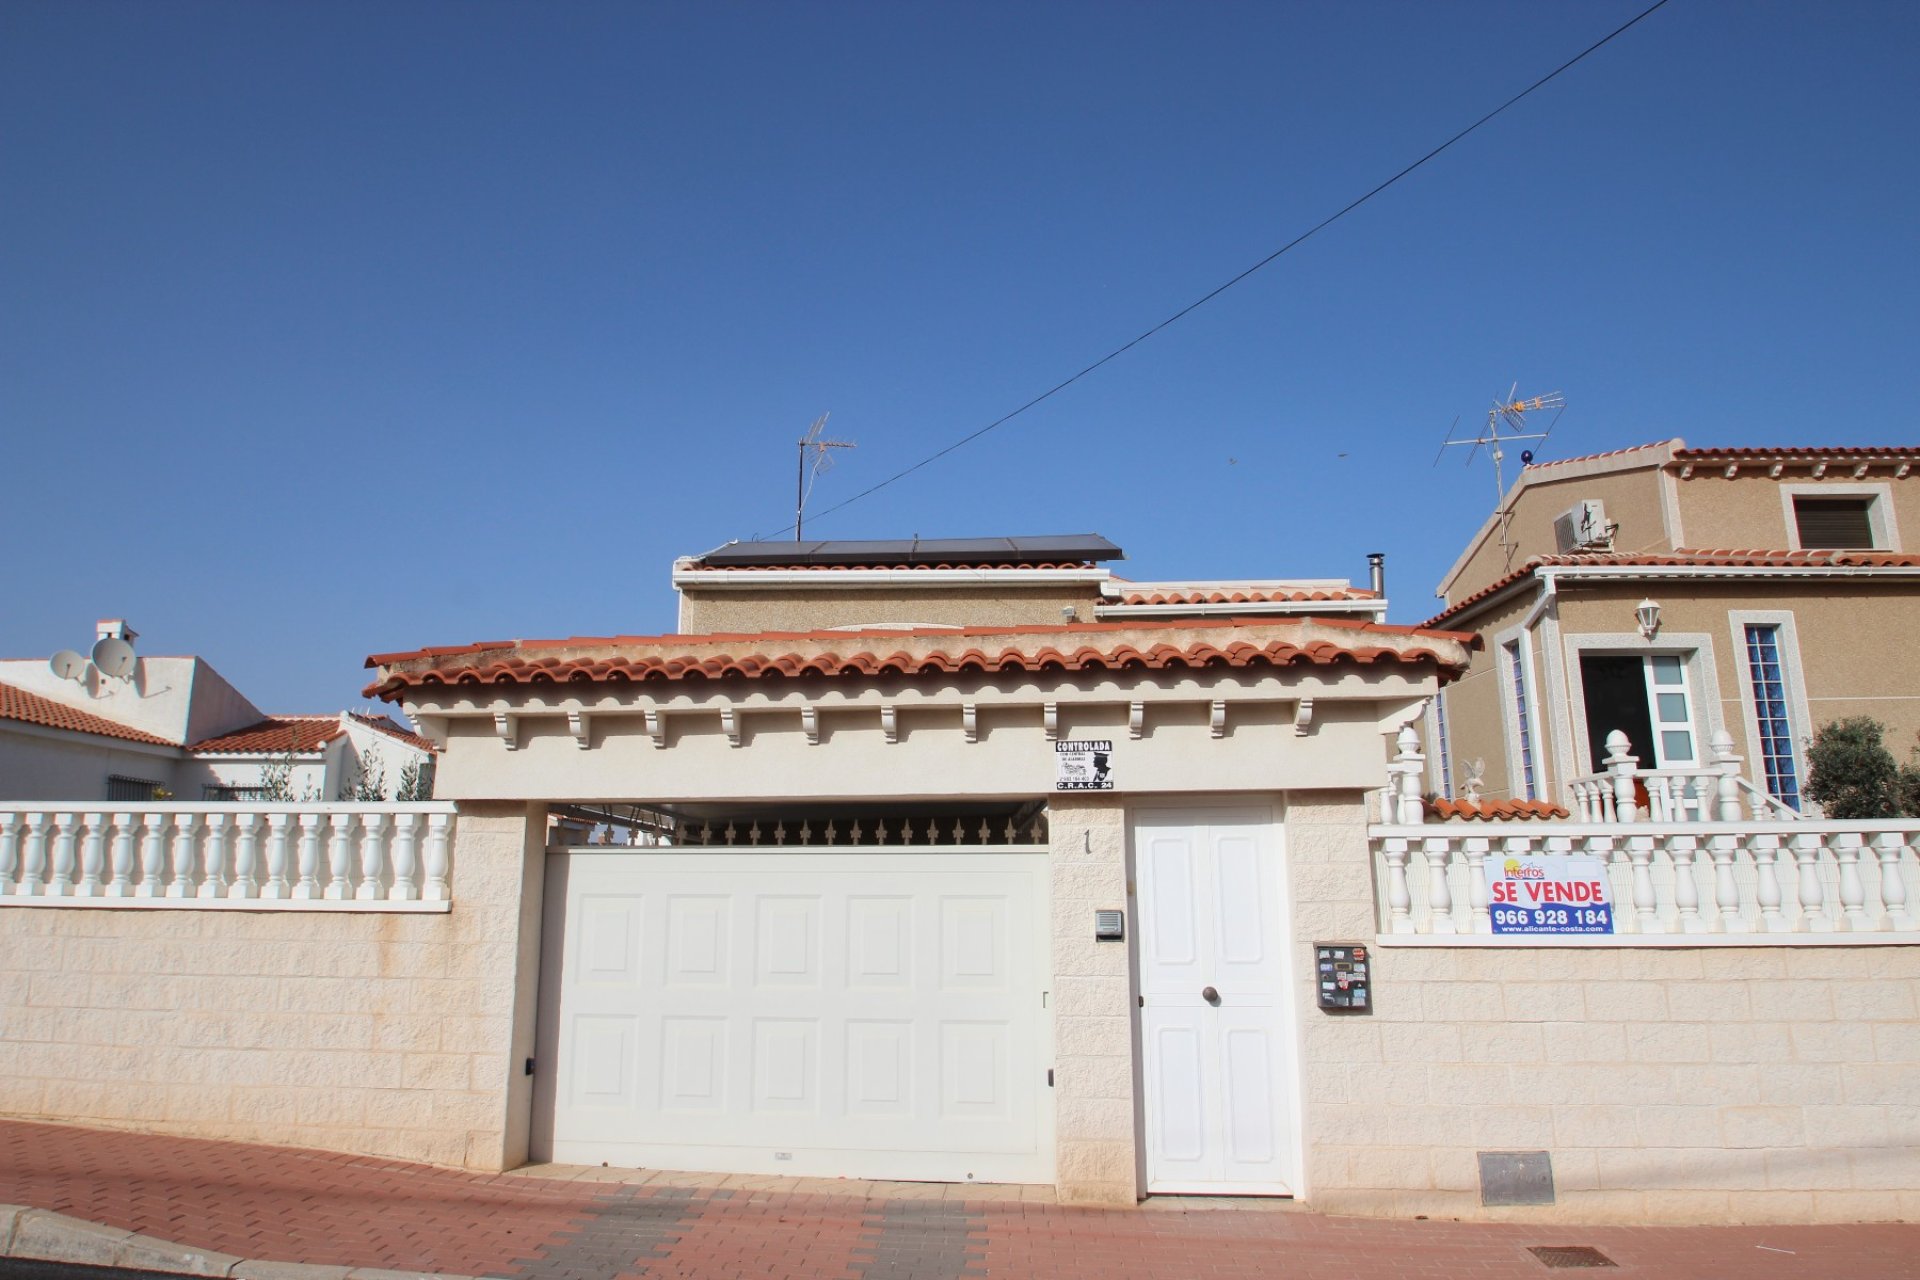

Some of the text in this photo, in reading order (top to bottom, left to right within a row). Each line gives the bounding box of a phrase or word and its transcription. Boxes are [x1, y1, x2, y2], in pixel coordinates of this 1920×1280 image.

[1057, 741, 1110, 752] CONTROLADA
[1492, 881, 1603, 902] SE VENDE
[1494, 909, 1607, 925] 966 928 184
